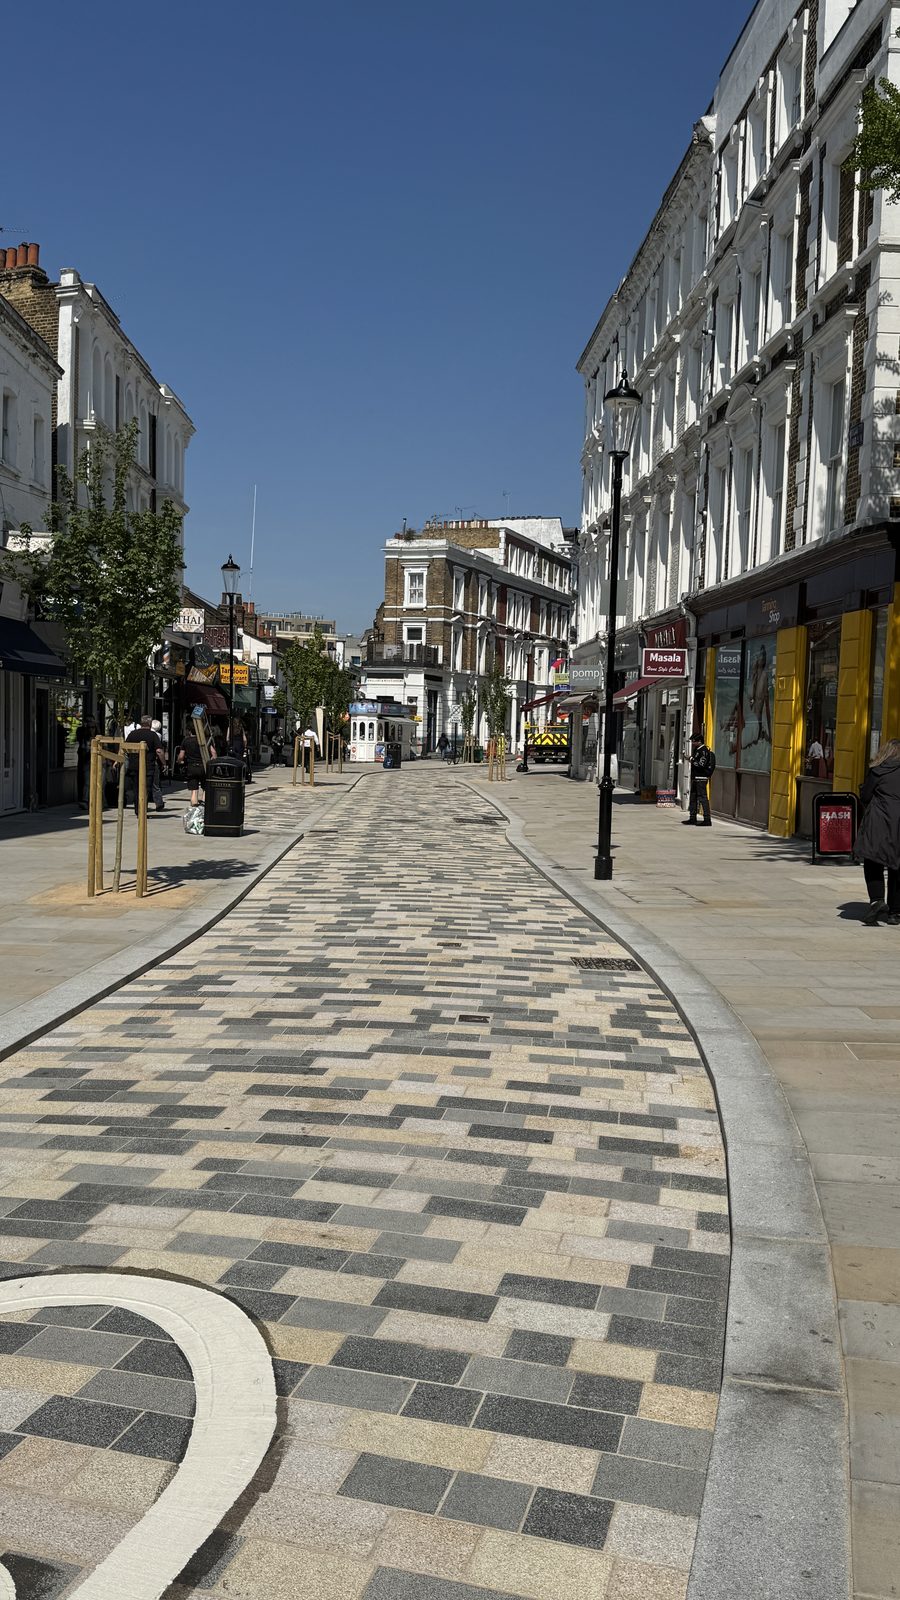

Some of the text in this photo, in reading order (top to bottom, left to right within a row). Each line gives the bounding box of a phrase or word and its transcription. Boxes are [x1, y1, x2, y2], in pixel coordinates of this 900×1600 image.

[177, 616, 201, 625] THAI
[769, 610, 780, 624] Shop
[650, 652, 681, 662] Masala
[572, 670, 600, 679] pomp
[668, 666, 683, 674] Cooking
[821, 811, 851, 820] FLASH
